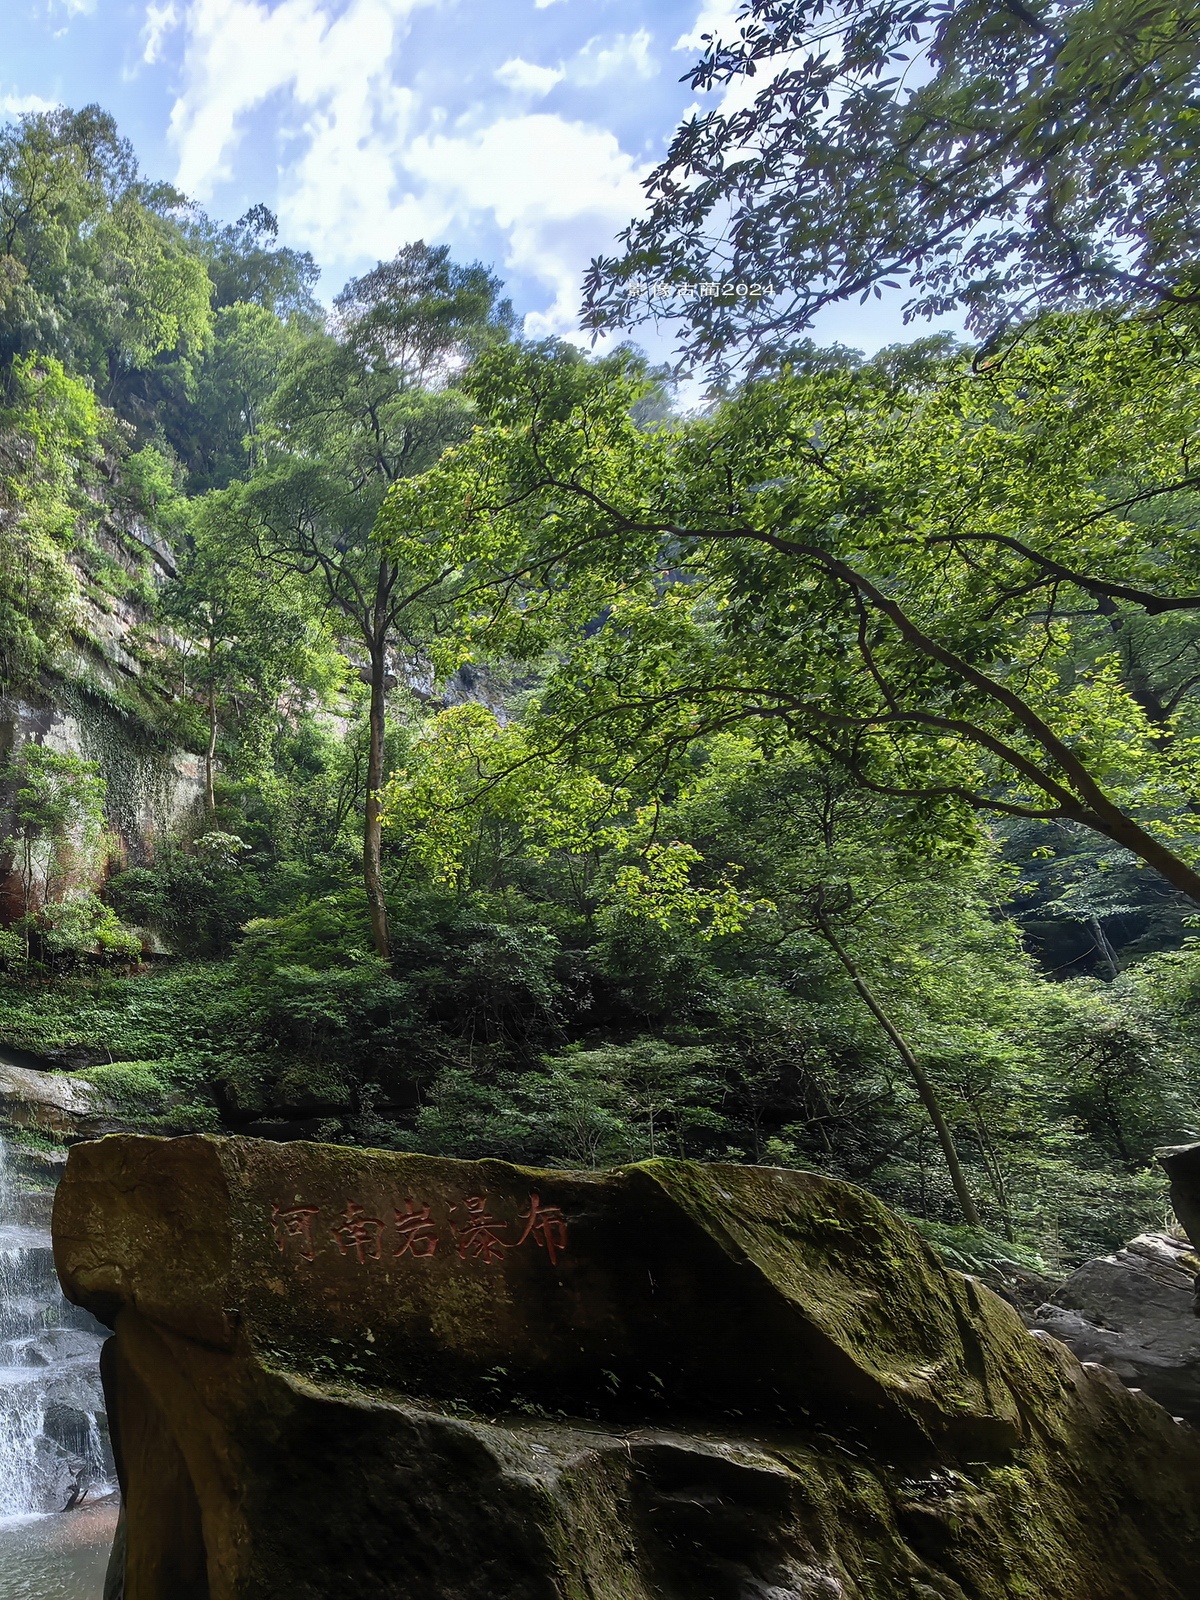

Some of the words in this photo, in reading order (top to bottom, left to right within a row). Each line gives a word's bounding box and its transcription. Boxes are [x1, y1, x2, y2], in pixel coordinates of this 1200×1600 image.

[271, 1193, 568, 1265] 河南岩瀑布
